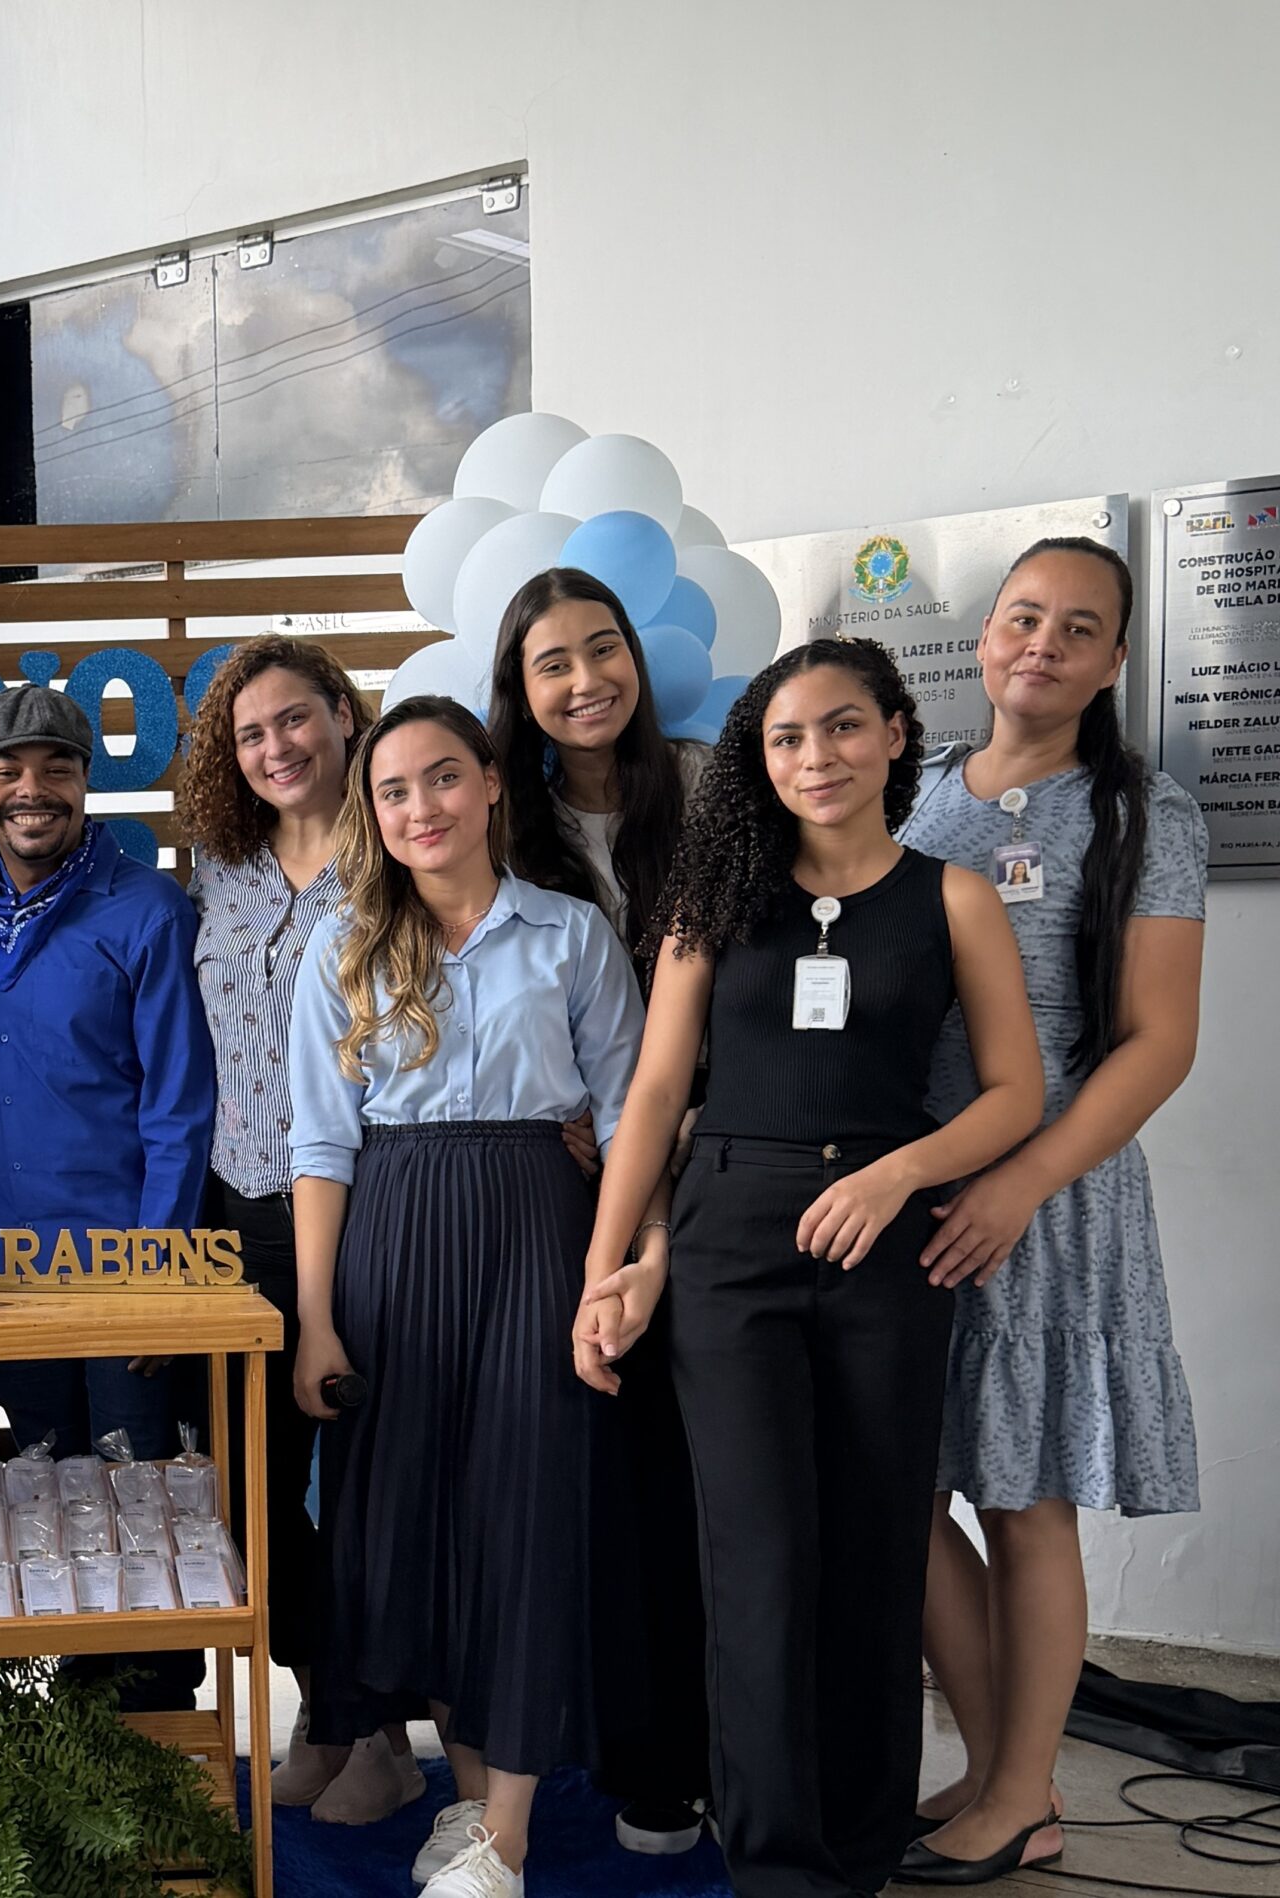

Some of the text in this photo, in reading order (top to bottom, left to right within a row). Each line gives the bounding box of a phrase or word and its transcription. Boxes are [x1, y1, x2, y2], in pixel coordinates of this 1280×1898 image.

[1178, 549, 1275, 569] CONSTRUÇÃO
[1200, 569, 1222, 581] DO
[1196, 584, 1215, 595] DE
[1218, 582, 1242, 594] RIO
[1214, 595, 1264, 608] VILELA
[884, 606, 902, 620] DA
[902, 642, 943, 658] LAZER
[946, 641, 955, 654] E
[1191, 666, 1221, 677] LUIZ
[1223, 661, 1271, 675] INÁCIO
[900, 673, 916, 685] DE
[918, 670, 941, 684] RIO
[909, 687, 956, 703] 005-18
[1175, 687, 1280, 705] NÍSIA VERÔNICA
[1188, 715, 1280, 731] HELDER ZALU
[925, 729, 977, 744] EFICENTE
[1212, 745, 1251, 757] IVETE
[1199, 771, 1252, 785] MÁRCIA
[1199, 800, 1265, 813] DIMILSON
